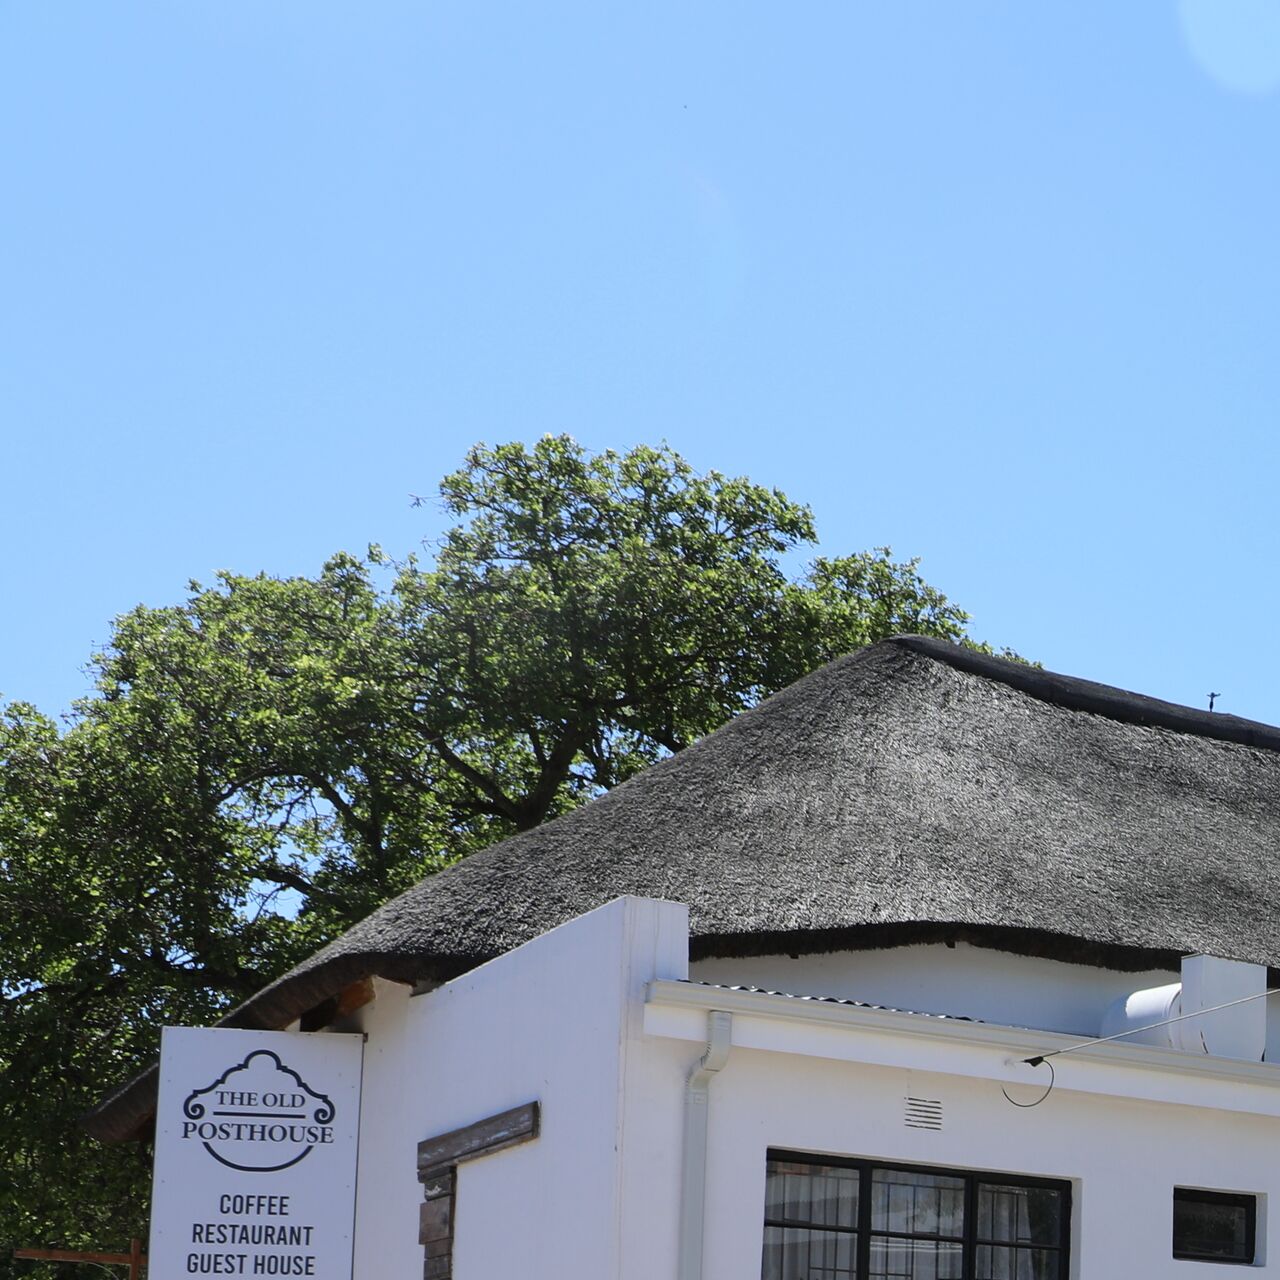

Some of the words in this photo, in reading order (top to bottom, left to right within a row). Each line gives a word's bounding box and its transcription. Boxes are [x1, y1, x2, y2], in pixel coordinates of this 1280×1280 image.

[215, 1091, 258, 1106] THE
[262, 1093, 306, 1108] OLD
[182, 1122, 334, 1144] POSTHOUSE
[220, 1194, 290, 1216] COFFEE
[192, 1223, 314, 1246] RESTAURANT
[187, 1253, 247, 1274] GUEST
[253, 1255, 316, 1276] HOUSE
